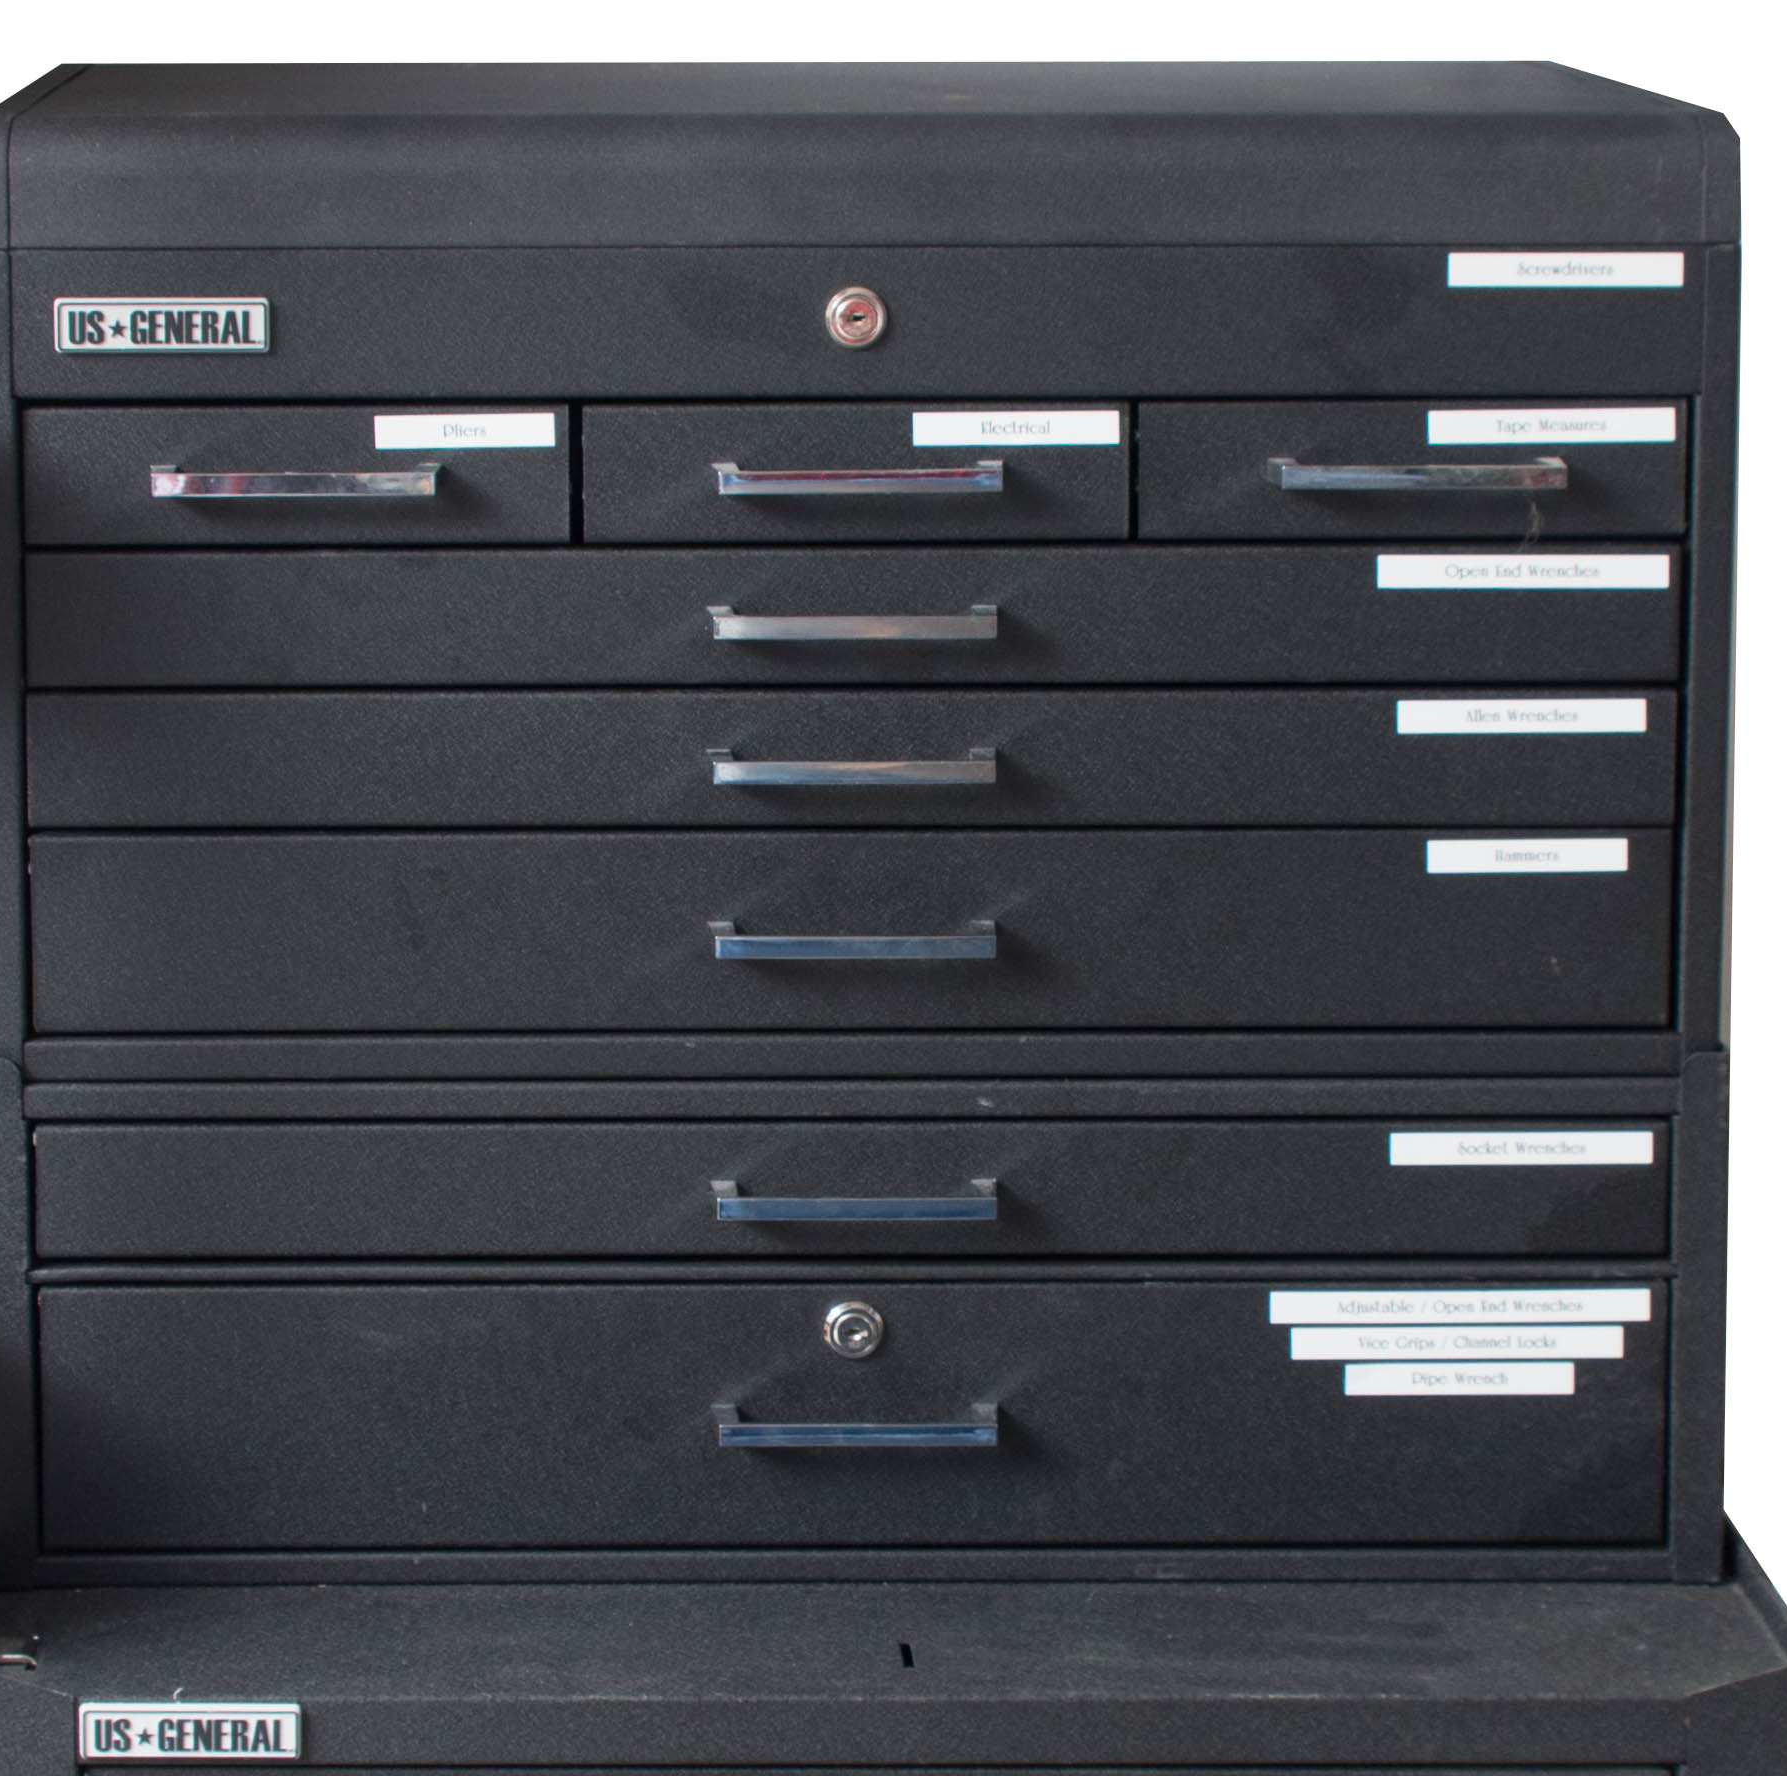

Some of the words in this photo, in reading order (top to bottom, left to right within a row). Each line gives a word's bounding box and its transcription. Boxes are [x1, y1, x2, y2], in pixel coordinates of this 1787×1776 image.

[1516, 260, 1614, 277] Screwdrivers
[67, 309, 106, 345] US
[129, 309, 258, 345] GENERAL
[442, 423, 487, 439] Pliers
[980, 419, 1051, 436] Electrical
[1496, 419, 1533, 436] Tape
[1539, 418, 1608, 433] Measures
[1444, 563, 1489, 581] Open
[1494, 563, 1523, 579] End
[1527, 563, 1601, 579] Wrenches
[1466, 708, 1502, 723] Allen
[1506, 708, 1579, 723] Wrenches
[1494, 848, 1561, 863] Hammers
[1457, 1140, 1508, 1156] Socket
[1514, 1140, 1587, 1156] Wrenches
[1337, 1299, 1414, 1315] Adjustable
[1432, 1299, 1475, 1315] Open
[1480, 1299, 1508, 1313] End
[1512, 1298, 1584, 1313] Wrenches
[1358, 1336, 1390, 1350] Vice
[1394, 1335, 1436, 1352] Grips
[1452, 1335, 1512, 1349] Channel
[1517, 1335, 1558, 1349] Locks
[1411, 1371, 1448, 1388] Pipe
[1453, 1371, 1509, 1385] Wrench
[94, 1717, 133, 1753] US
[157, 1717, 289, 1753] GENERAL
